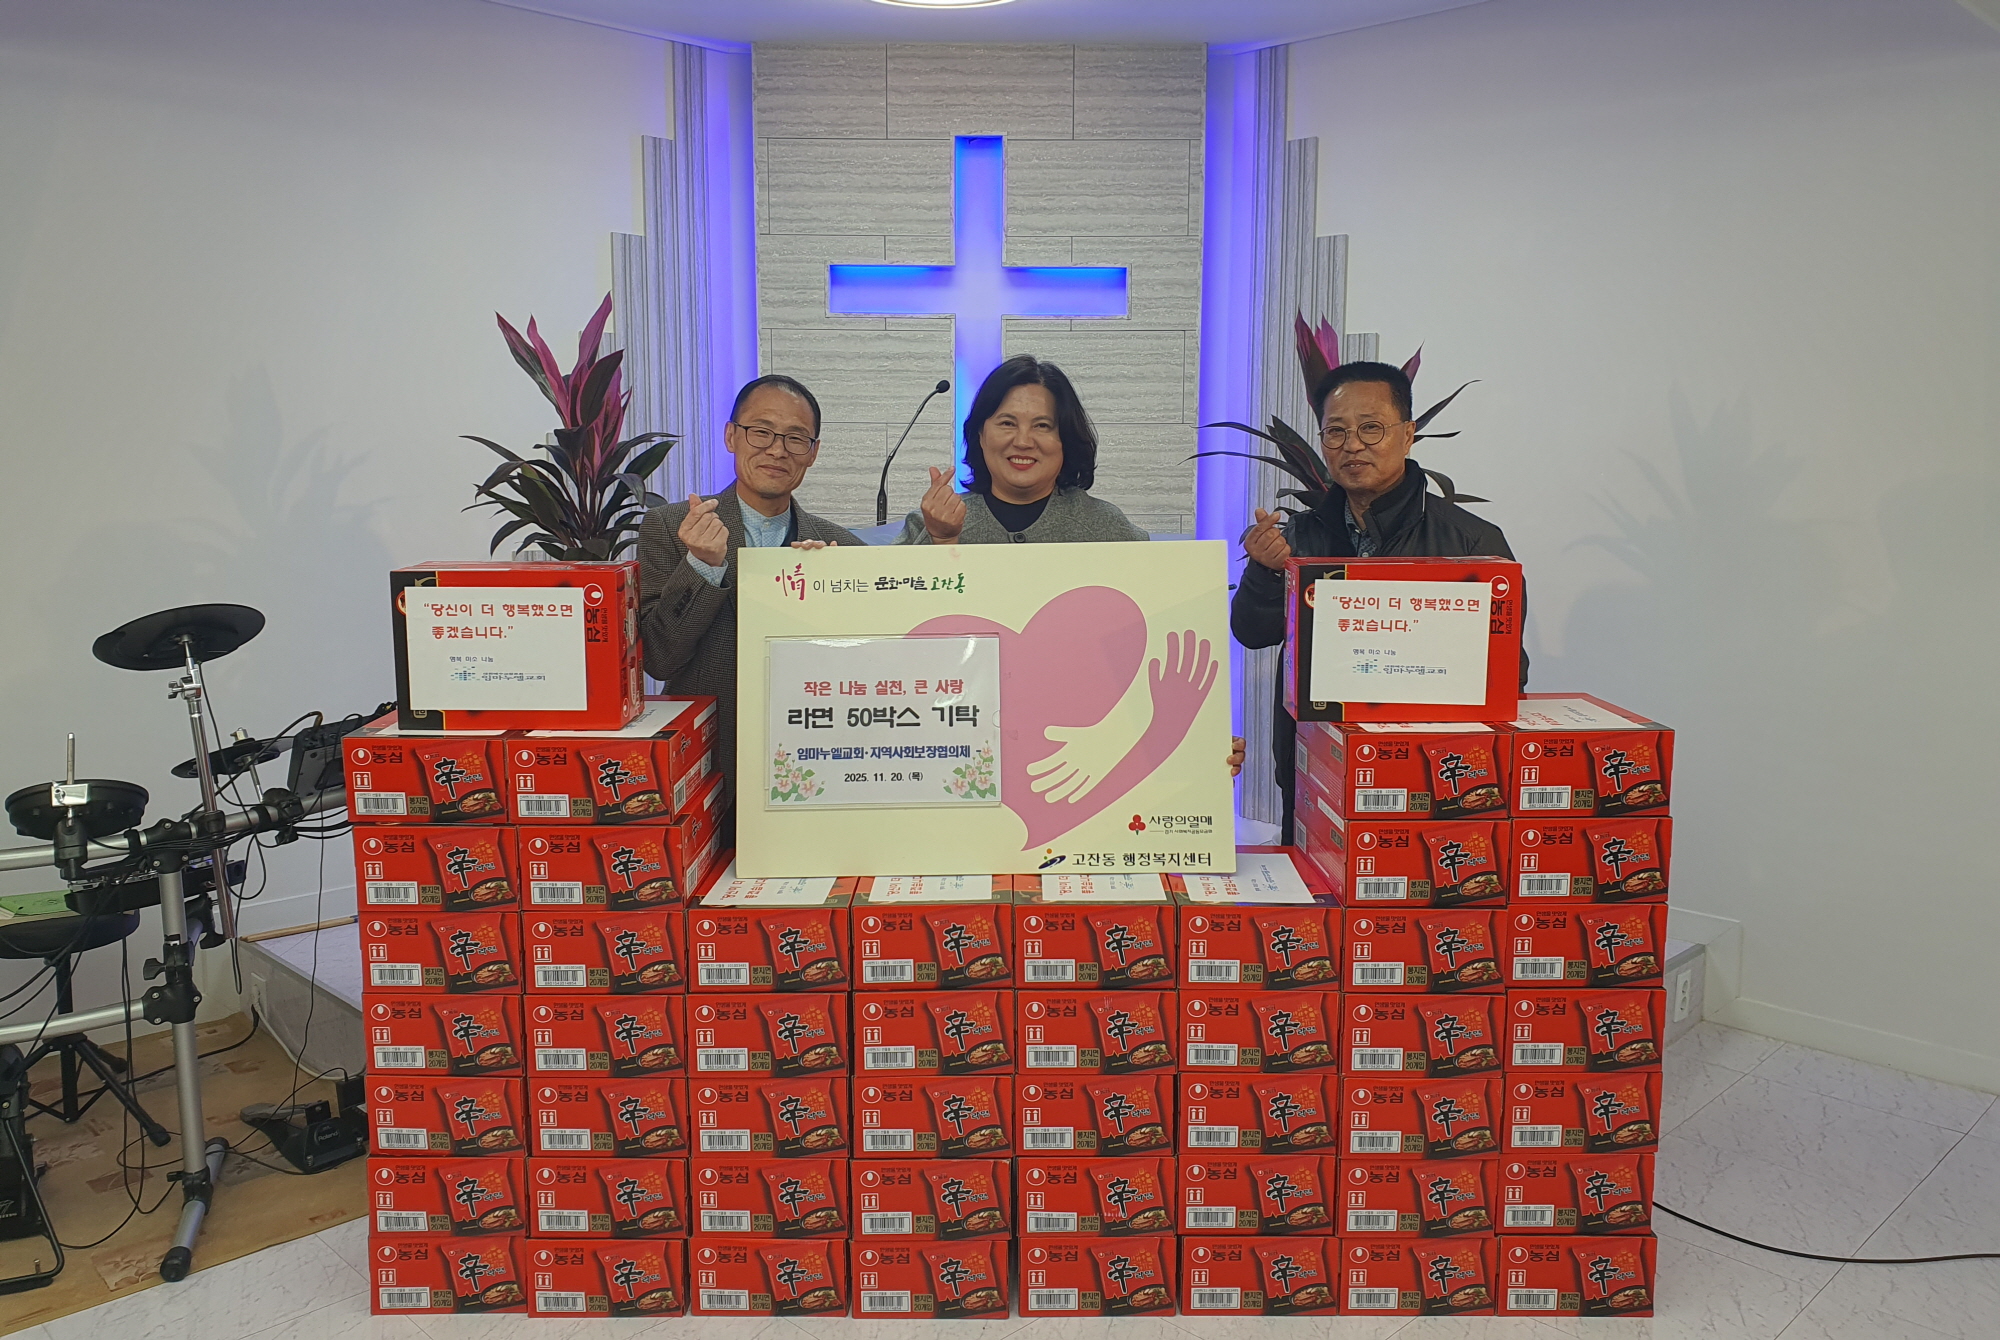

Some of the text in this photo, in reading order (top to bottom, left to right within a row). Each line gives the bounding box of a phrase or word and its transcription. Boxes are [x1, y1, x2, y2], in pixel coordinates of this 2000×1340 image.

[813, 580, 824, 593] 이
[831, 579, 868, 592] 넘치는
[931, 573, 965, 593] 고잔동
[482, 604, 493, 616] 더
[502, 604, 572, 617] 행복했으면
[1389, 598, 1401, 610] 더
[1410, 598, 1479, 612] 행복했으면
[1489, 598, 1507, 635] 농심
[585, 608, 601, 643] 농심
[804, 679, 964, 696] 작은 나눔 실천, 큰 사랑
[788, 705, 980, 729] 라면 50박스 기탁
[1378, 747, 1409, 760] 농심
[1543, 745, 1574, 758] 농심
[372, 752, 403, 764] 농심
[536, 753, 567, 766] 농심
[845, 772, 923, 782] 2025. 11. 20. (목)
[1410, 802, 1430, 811] 20개입
[1573, 799, 1594, 808] 20개입
[409, 806, 430, 815] 20개입
[572, 808, 593, 817] 20개입
[1149, 816, 1212, 828] 사랑의열매
[1378, 836, 1410, 849] 농심
[1542, 832, 1573, 845] 농심
[384, 841, 415, 854] 농심
[550, 841, 581, 854] 농심
[1073, 853, 1210, 866] 고잔동 행정복지센터
[1410, 890, 1431, 898] 20개입
[1573, 887, 1593, 895] 20개입
[421, 895, 441, 904] 20개입
[585, 895, 606, 903] 20개입
[718, 922, 748, 935] 농심
[882, 919, 913, 932] 농심
[1045, 919, 1075, 932] 농심
[1210, 920, 1241, 932] 농심
[1375, 922, 1406, 935] 농심
[1536, 917, 1567, 930] 농심
[388, 924, 419, 936] 농심
[554, 925, 584, 937] 농심
[392, 1007, 422, 1019] 농심
[554, 1009, 584, 1022] 농심
[716, 1008, 747, 1021] 농심
[884, 1006, 914, 1018] 농심
[1046, 1005, 1077, 1018] 농심
[1208, 1004, 1239, 1017] 농심
[1374, 1008, 1405, 1021] 농심
[1535, 1003, 1566, 1016] 농심
[751, 1061, 771, 1070] 20개입
[395, 1090, 425, 1102] 농심
[558, 1090, 588, 1103] 농심
[718, 1090, 749, 1103] 농심
[882, 1090, 913, 1102] 농심
[1043, 1088, 1074, 1100] 농심
[1210, 1087, 1240, 1099] 농심
[1373, 1092, 1404, 1104] 농심
[1534, 1086, 1565, 1098] 농심
[753, 1142, 773, 1151] 20개입
[395, 1172, 426, 1184] 농심
[557, 1172, 587, 1184] 농심
[719, 1172, 749, 1184] 농심
[1047, 1172, 1078, 1184] 농심
[1207, 1168, 1238, 1180] 농심
[1369, 1171, 1400, 1184] 농심
[1526, 1166, 1557, 1178] 농심
[881, 1173, 912, 1186] 농심
[398, 1248, 429, 1261] 농심
[554, 1253, 584, 1266] 농심
[718, 1252, 747, 1264] 농심
[880, 1253, 910, 1265] 농심
[1048, 1250, 1078, 1262] 농심
[1212, 1250, 1242, 1262] 농심
[1370, 1250, 1400, 1262] 농심
[1530, 1250, 1560, 1262] 농심
